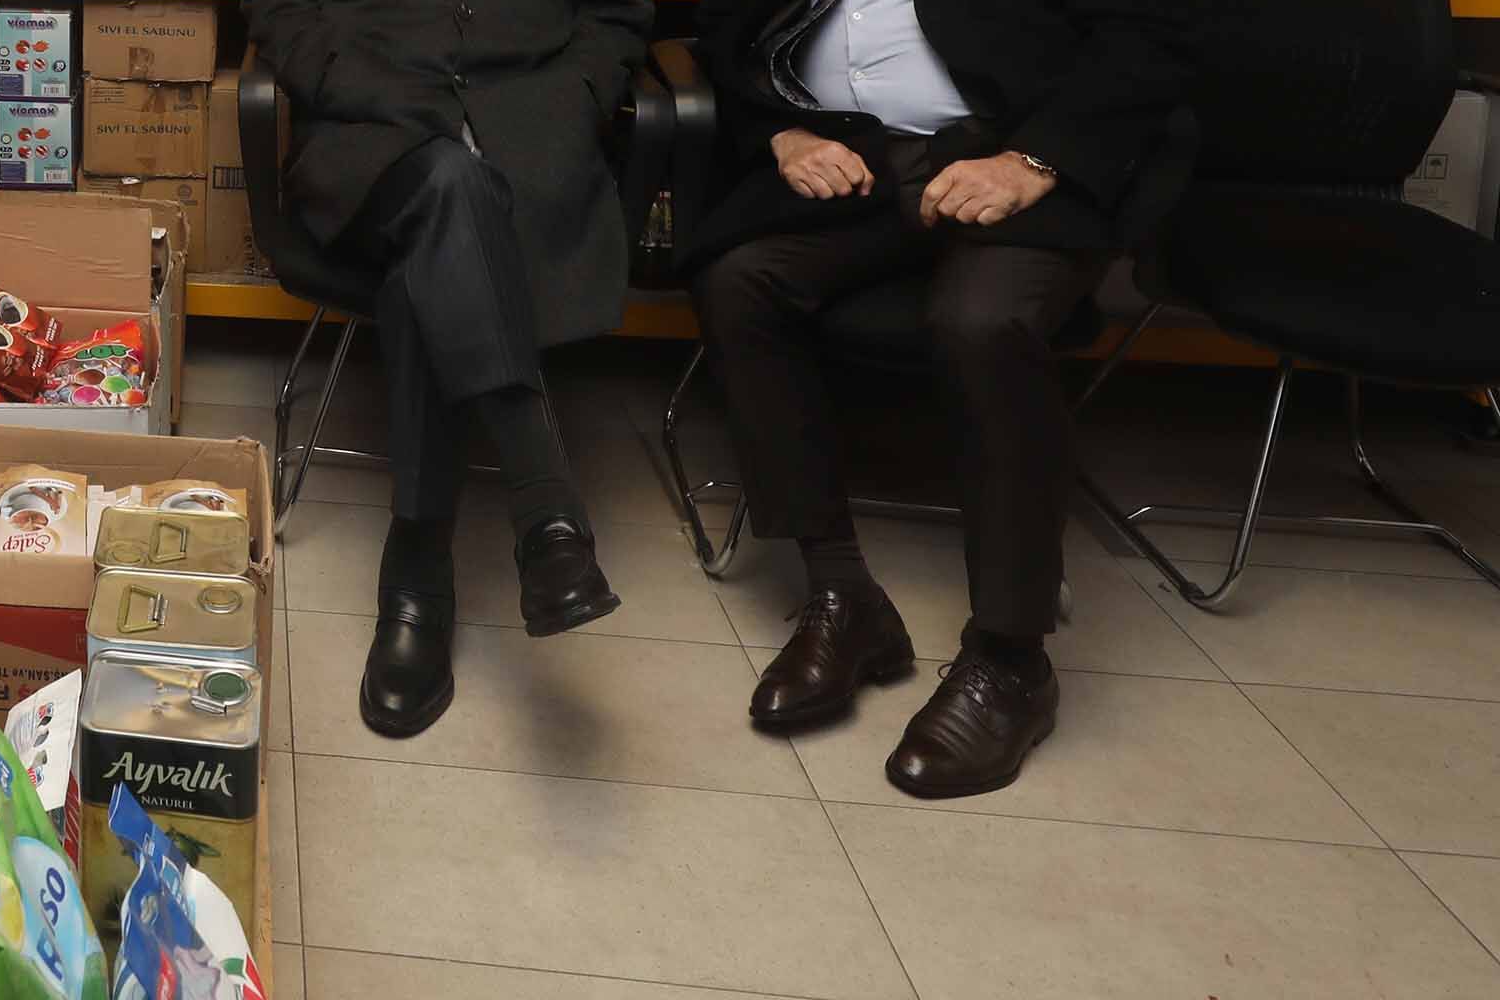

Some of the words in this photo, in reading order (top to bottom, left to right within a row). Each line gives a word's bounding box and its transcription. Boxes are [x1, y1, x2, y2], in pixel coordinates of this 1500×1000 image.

[142, 26, 197, 38] SABUNU
[2, 533, 52, 554] Salep
[102, 751, 236, 797] Ayvalık
[141, 795, 196, 810] NATUREL
